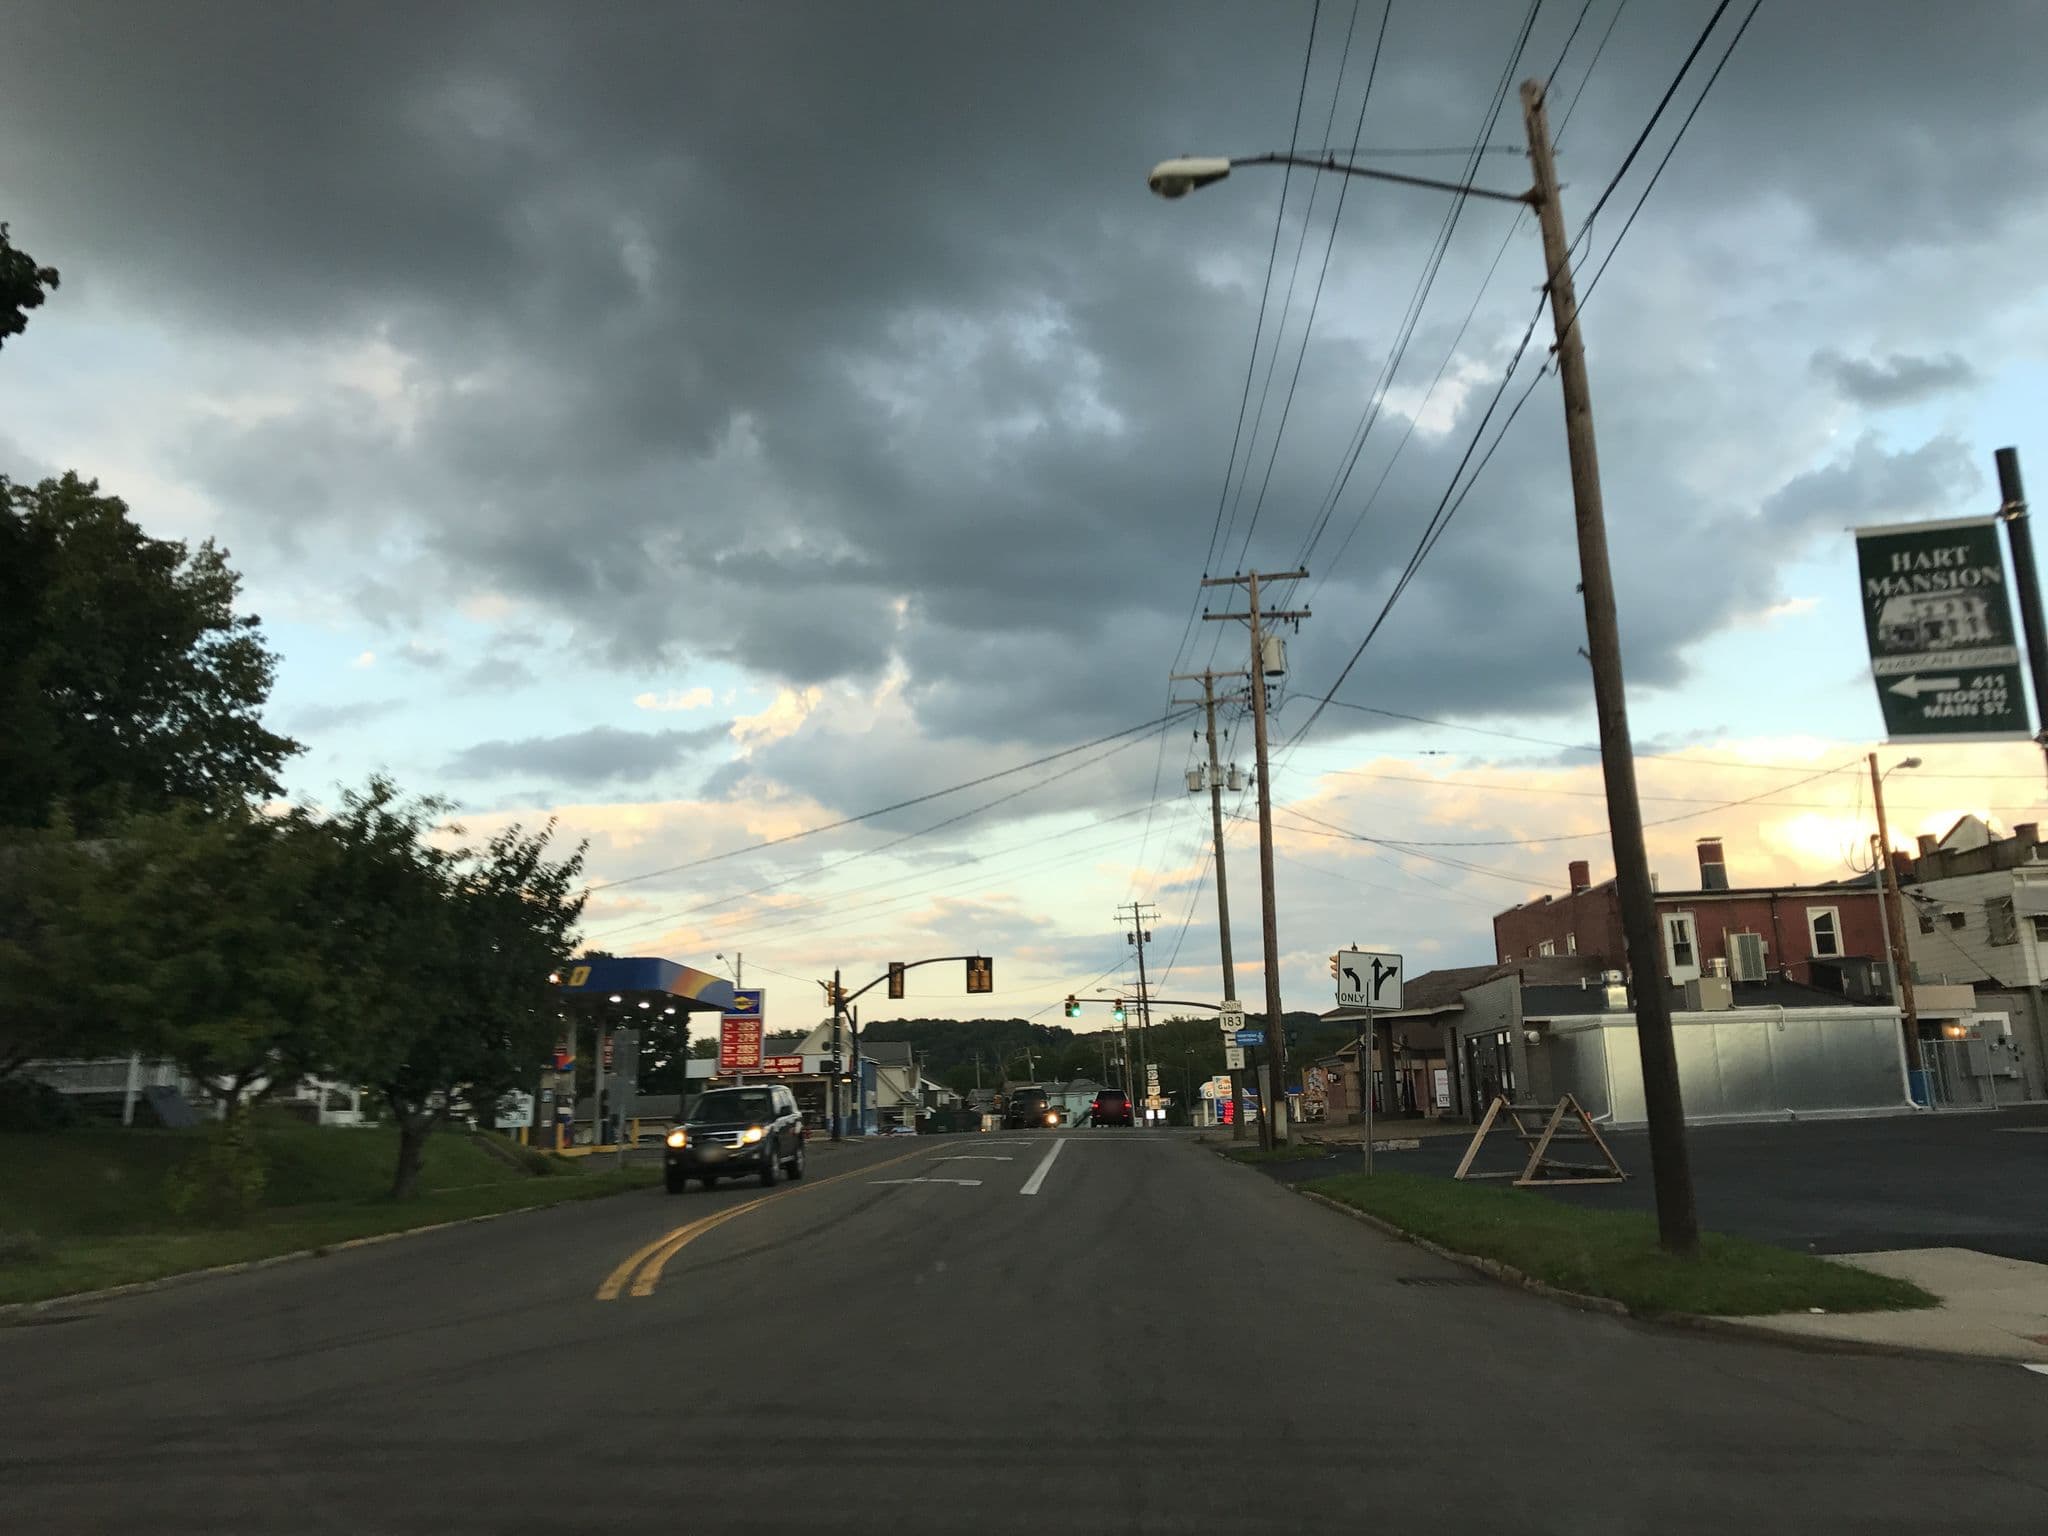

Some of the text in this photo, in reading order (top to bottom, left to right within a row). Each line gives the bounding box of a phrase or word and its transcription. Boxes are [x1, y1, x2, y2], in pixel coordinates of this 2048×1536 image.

[1890, 545, 1970, 572] HART
[1866, 565, 2001, 598] MANSION
[1971, 673, 2006, 689] 411
[1936, 687, 2009, 706] NORTH
[1923, 703, 1980, 718] MAIN
[1341, 992, 1365, 1003] ONLY
[1222, 1001, 1241, 1010] SOUTH
[1223, 1016, 1242, 1027] 183
